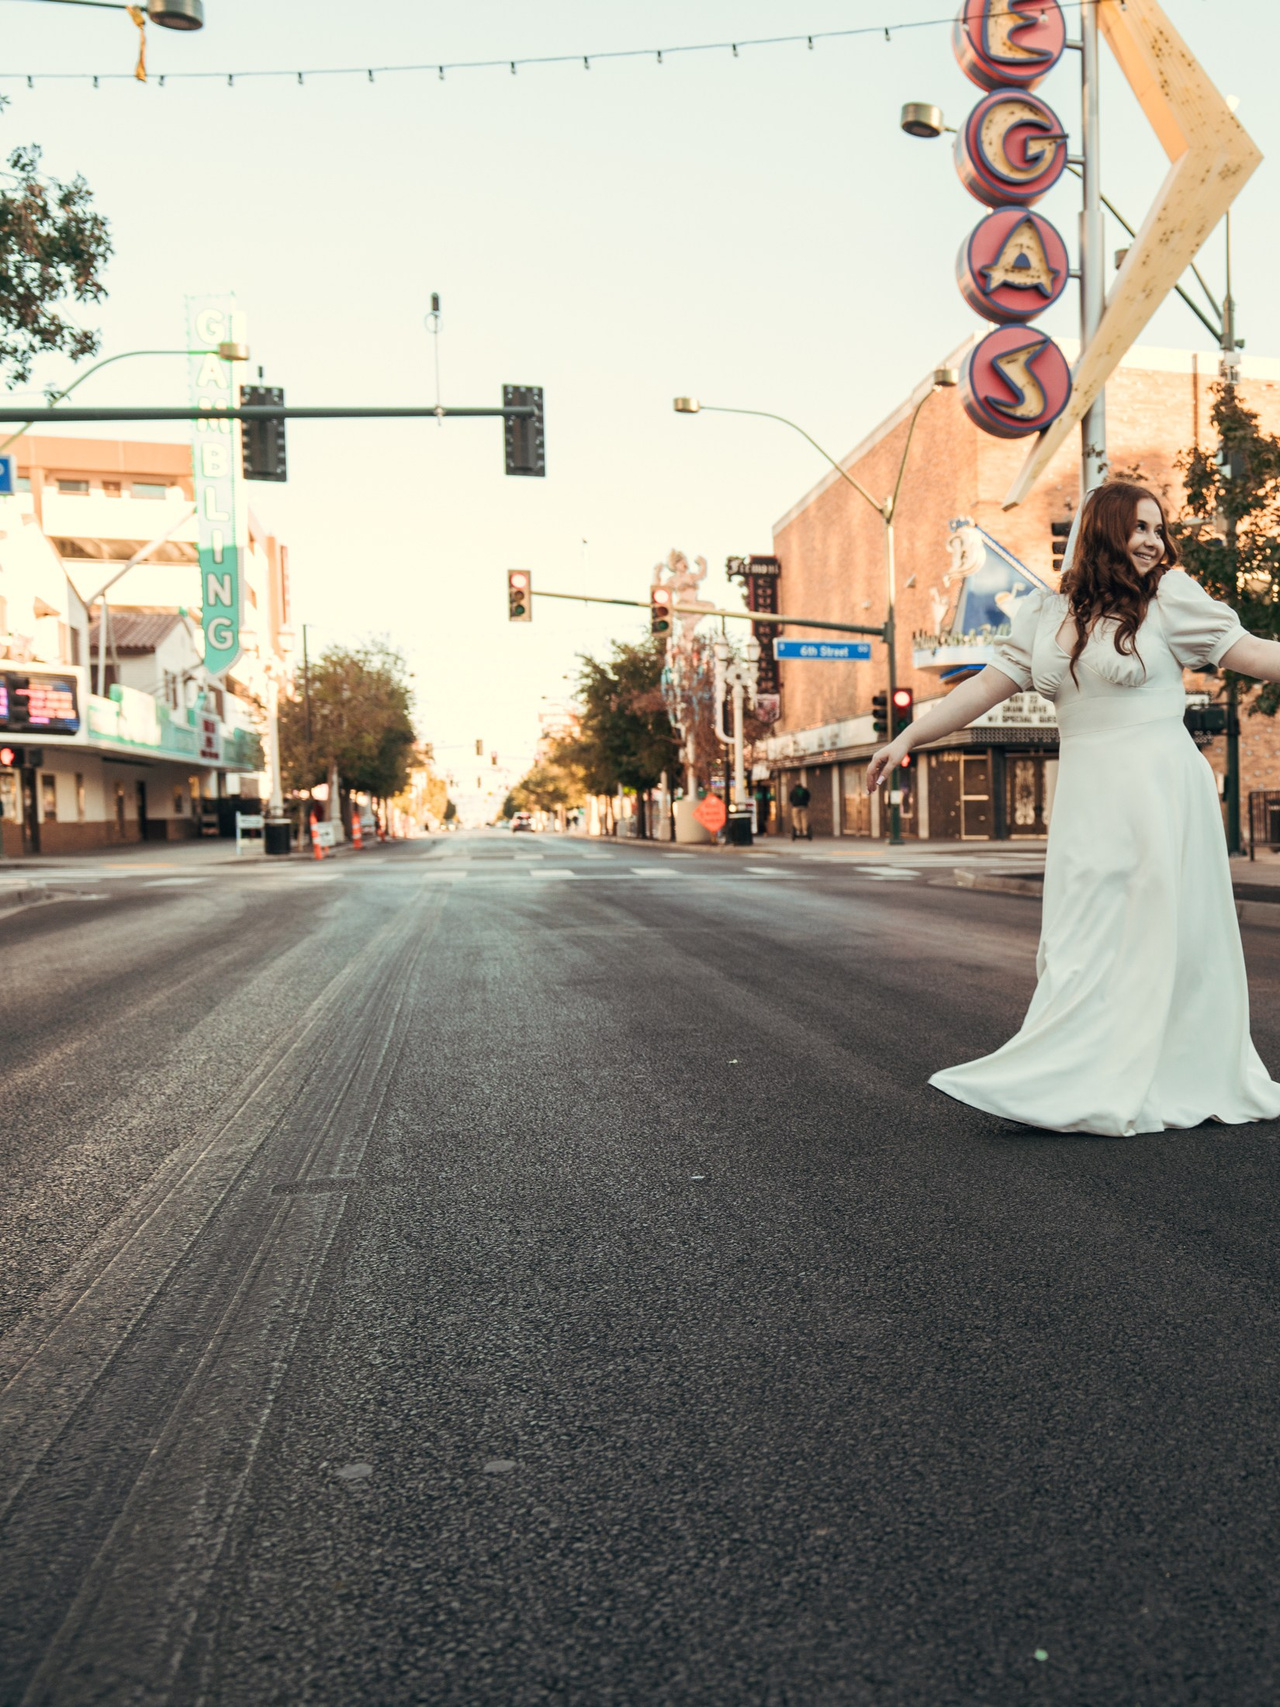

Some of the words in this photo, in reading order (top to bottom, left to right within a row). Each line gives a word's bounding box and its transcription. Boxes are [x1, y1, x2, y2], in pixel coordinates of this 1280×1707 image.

[195, 308, 235, 650] GAMBLING
[800, 645, 818, 656] 6th
[820, 645, 849, 657] Street
[1002, 715, 1032, 723] SPECIAL
